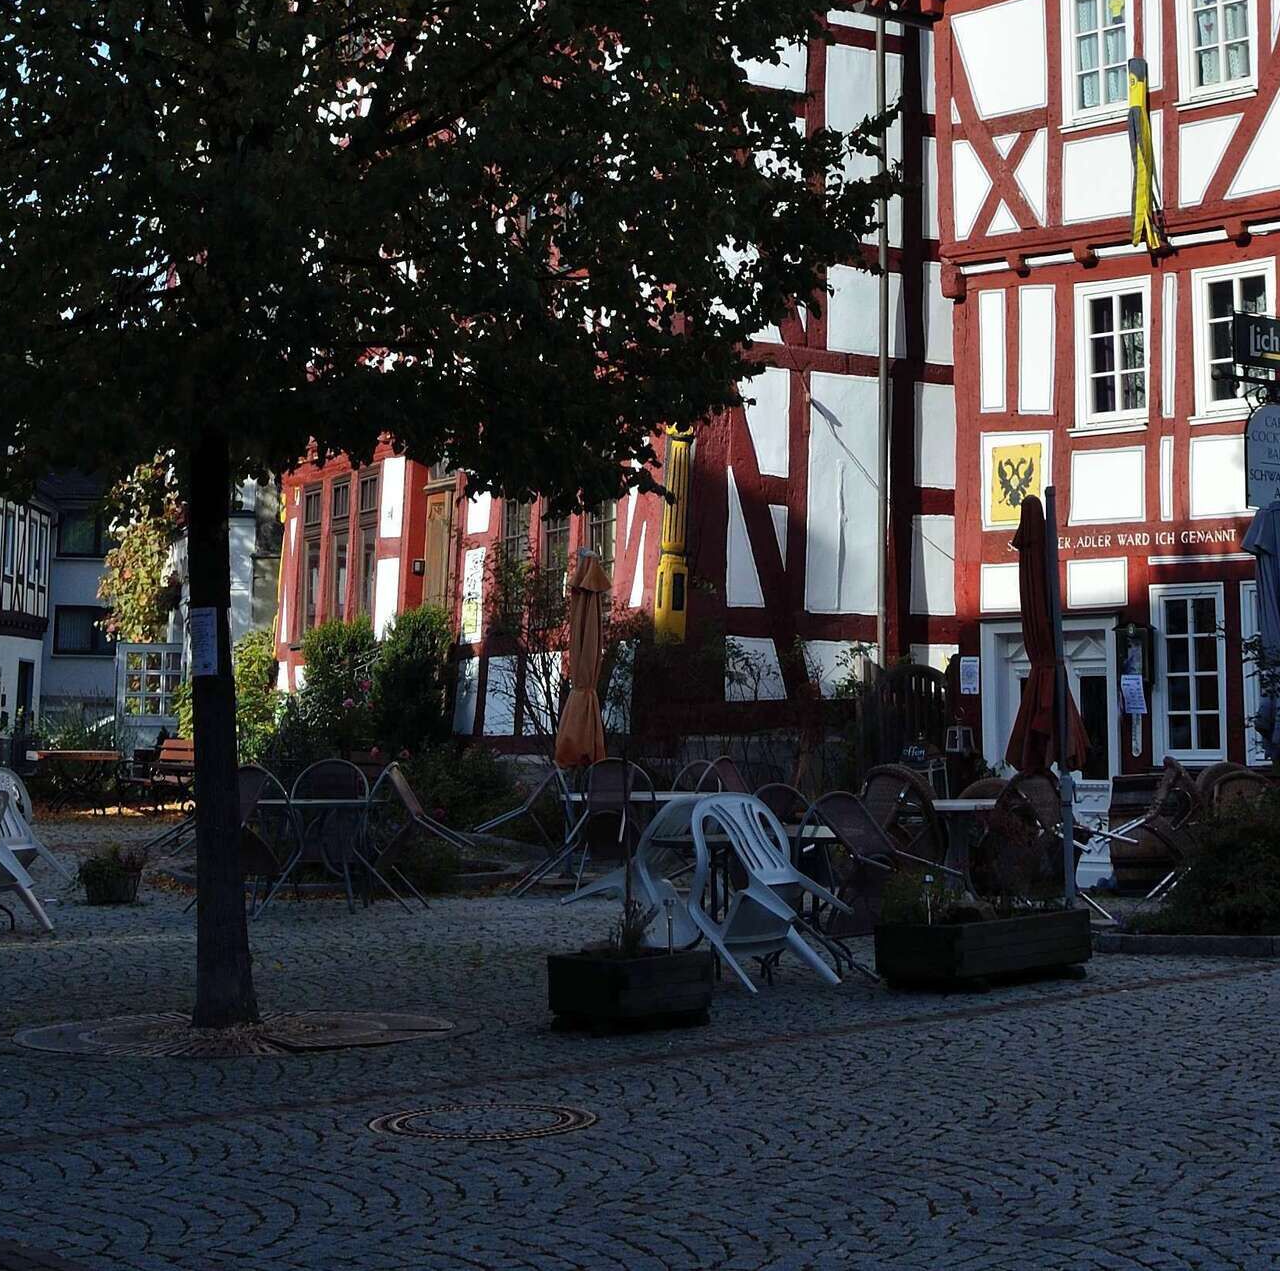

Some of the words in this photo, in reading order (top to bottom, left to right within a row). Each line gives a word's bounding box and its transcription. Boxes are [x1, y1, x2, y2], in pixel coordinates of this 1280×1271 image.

[1117, 532, 1150, 546] WARD
[1156, 531, 1175, 545] ICH
[1181, 528, 1237, 543] GENANNT
